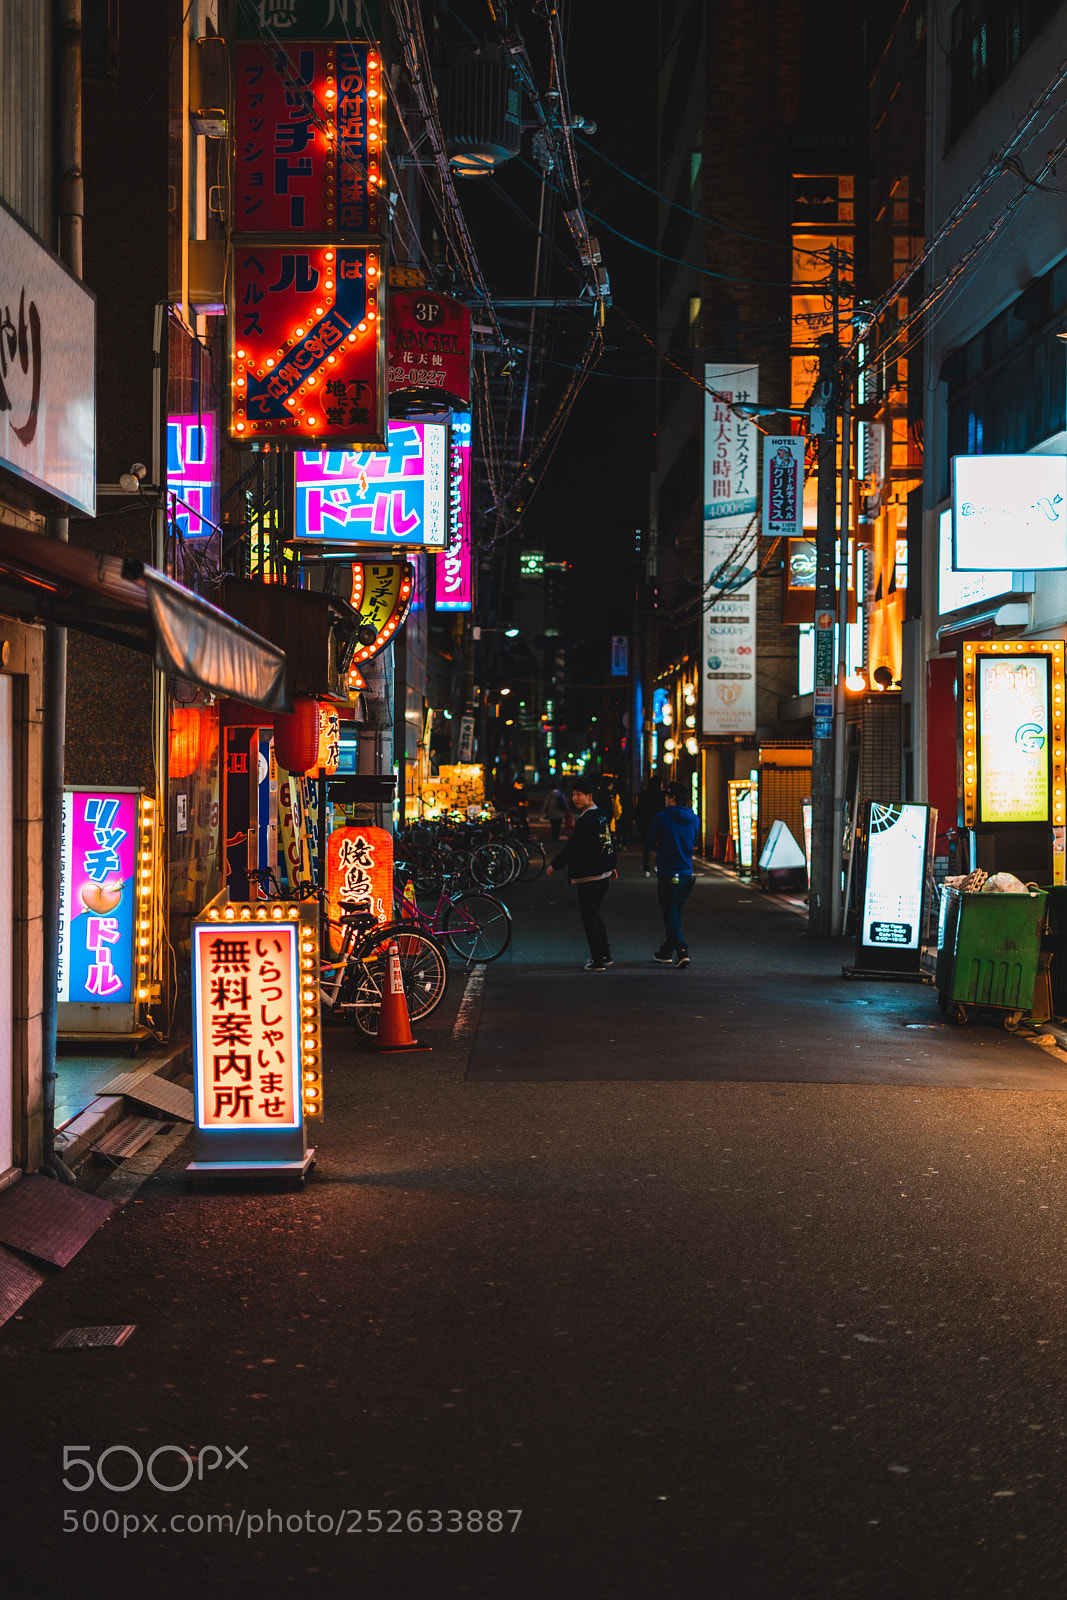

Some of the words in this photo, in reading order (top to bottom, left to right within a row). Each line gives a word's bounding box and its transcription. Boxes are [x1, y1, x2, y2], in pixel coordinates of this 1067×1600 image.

[416, 303, 439, 321] 3F
[393, 331, 465, 354] ANGEL
[403, 351, 443, 366] 花天使
[735, 390, 751, 496] サビスタイム
[306, 488, 421, 537] ドール
[772, 467, 785, 520] クリスマス
[208, 937, 254, 1122] 無料案内所
[255, 937, 286, 1121] いらっしゃいませ
